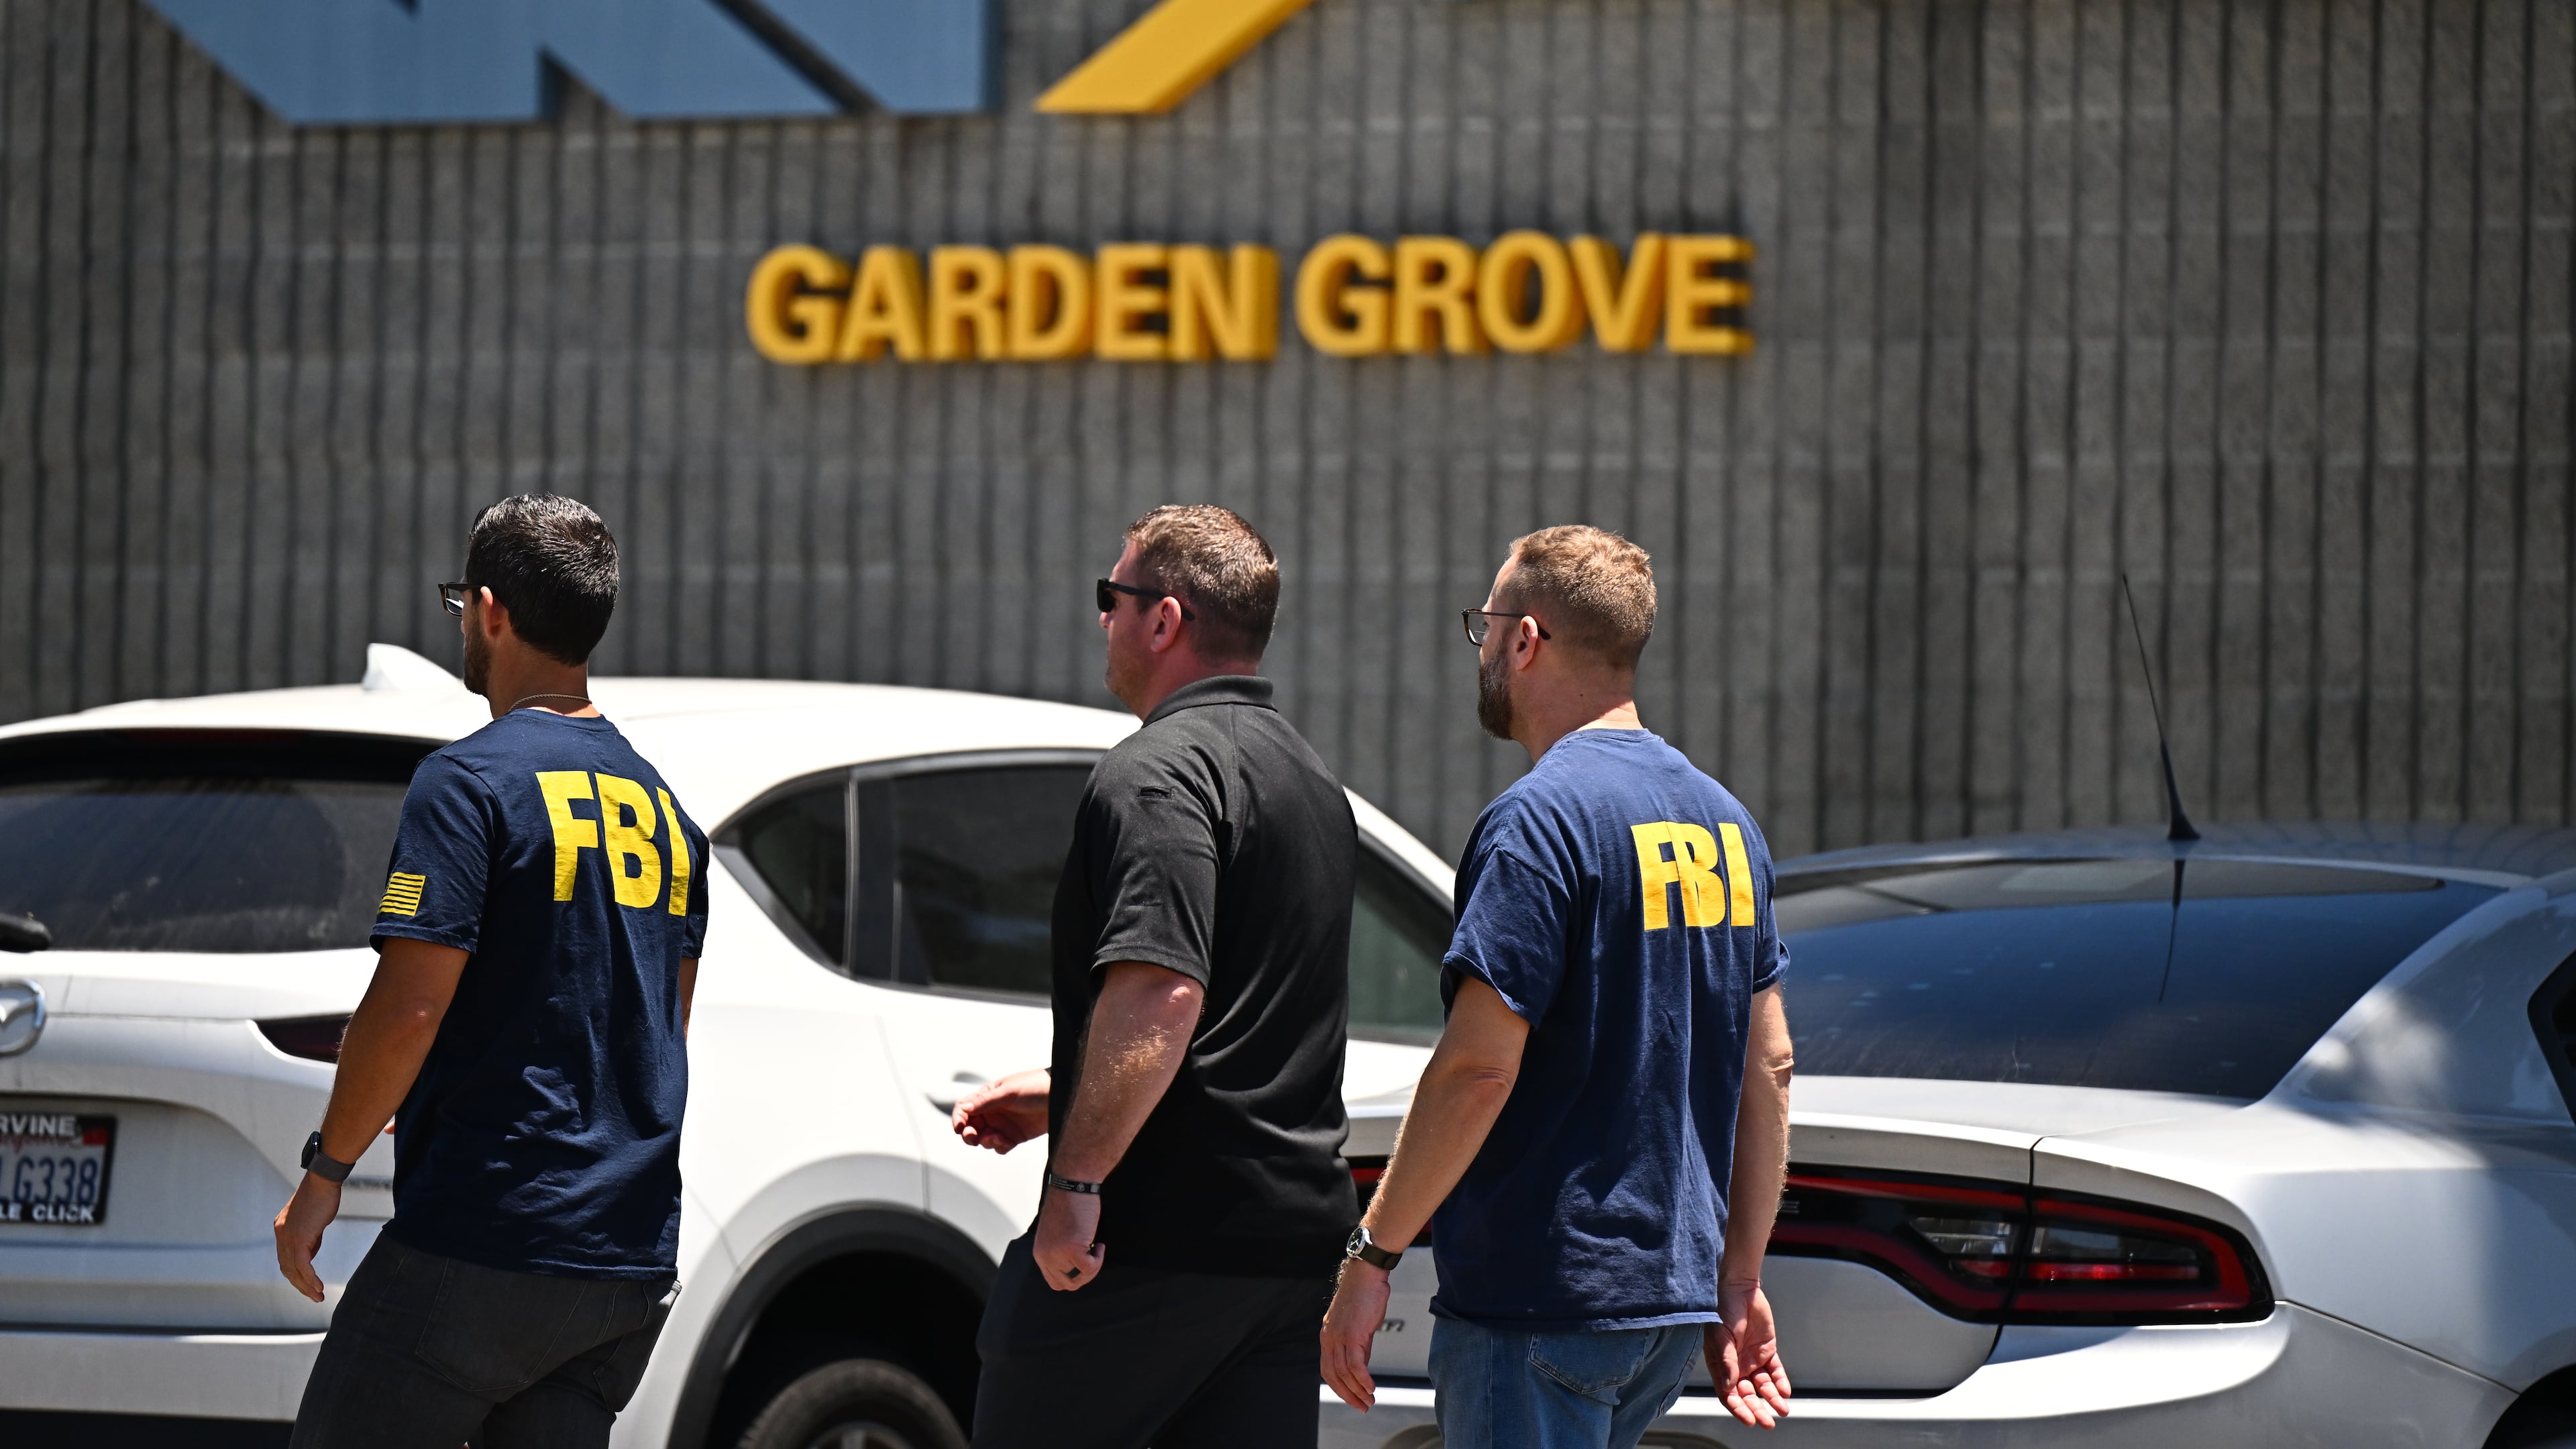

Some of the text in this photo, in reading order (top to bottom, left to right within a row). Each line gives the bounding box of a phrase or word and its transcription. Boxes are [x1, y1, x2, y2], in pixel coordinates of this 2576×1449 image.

[746, 230, 1756, 366] GARDEN GROVE
[535, 770, 691, 917] FBI
[1631, 820, 1755, 930] FBI
[32, 1203, 94, 1223] CLICK
